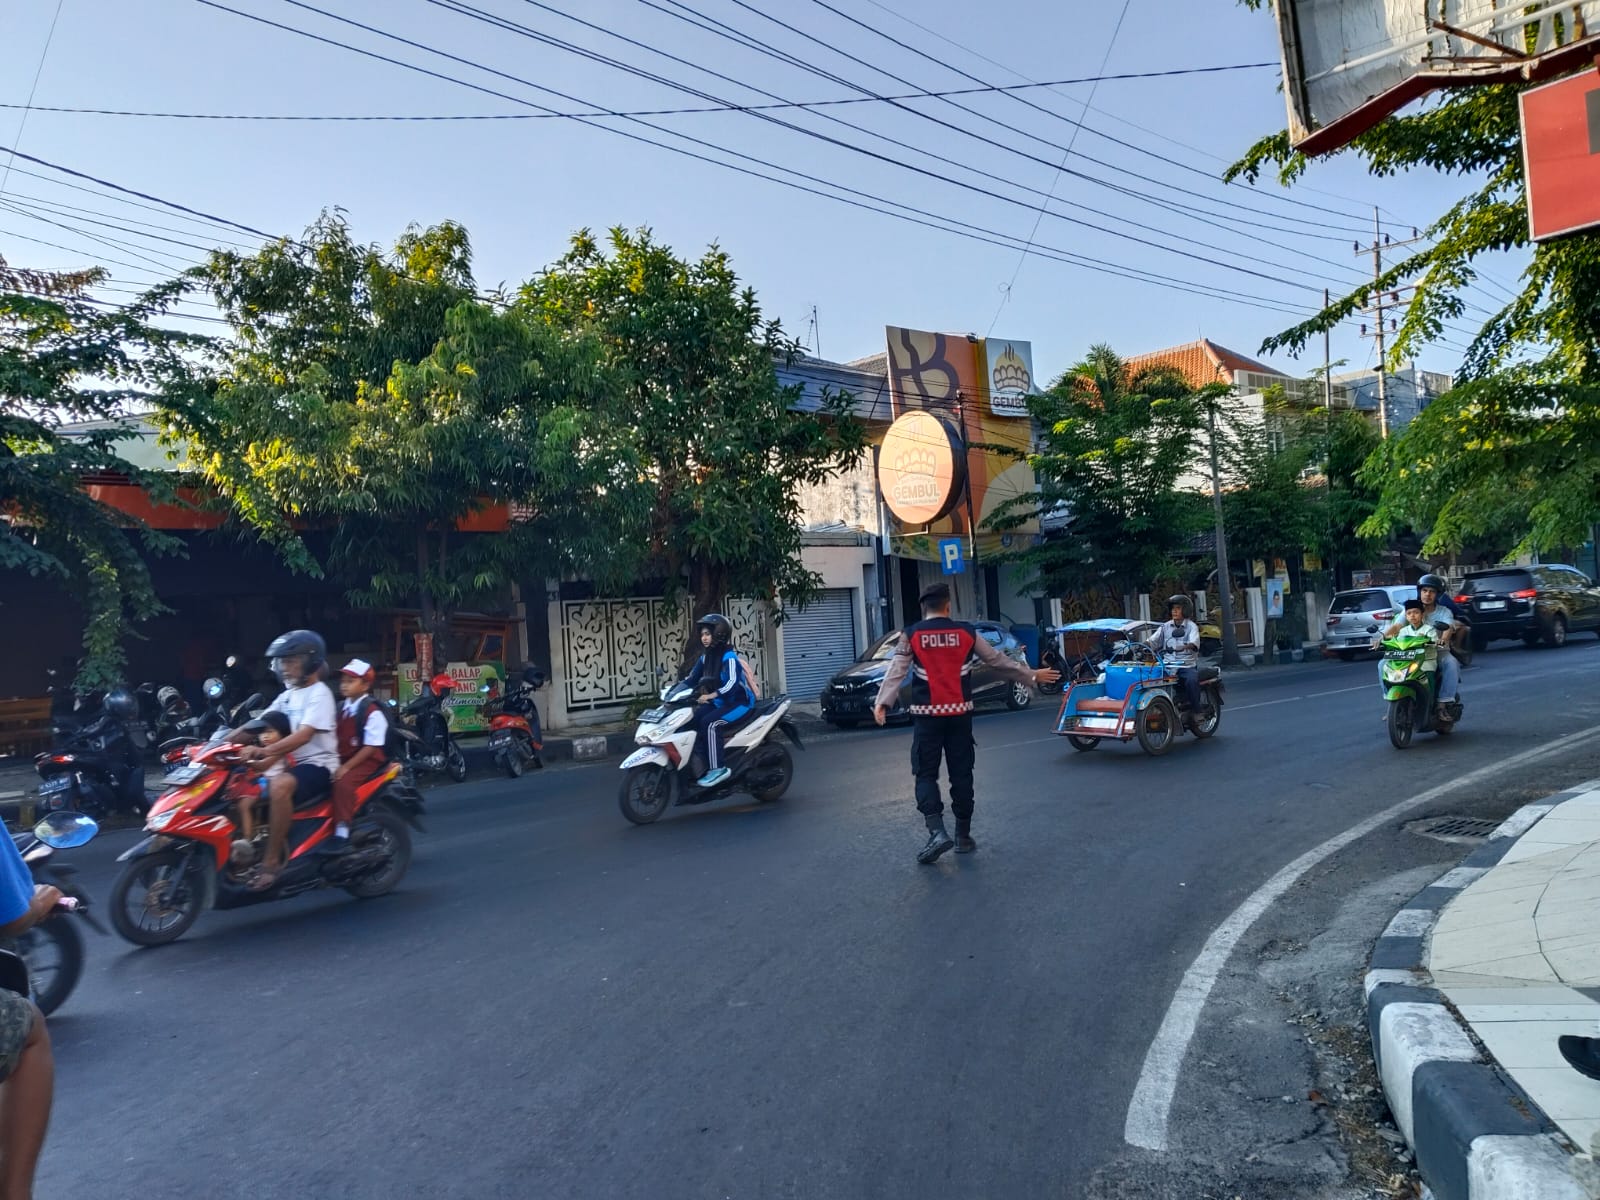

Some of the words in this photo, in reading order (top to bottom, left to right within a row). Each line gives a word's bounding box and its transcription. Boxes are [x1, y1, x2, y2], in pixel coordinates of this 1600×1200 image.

[893, 483, 940, 499] GEMBUL
[944, 544, 959, 569] P
[921, 632, 960, 648] POLISI
[451, 667, 480, 680] BALAP
